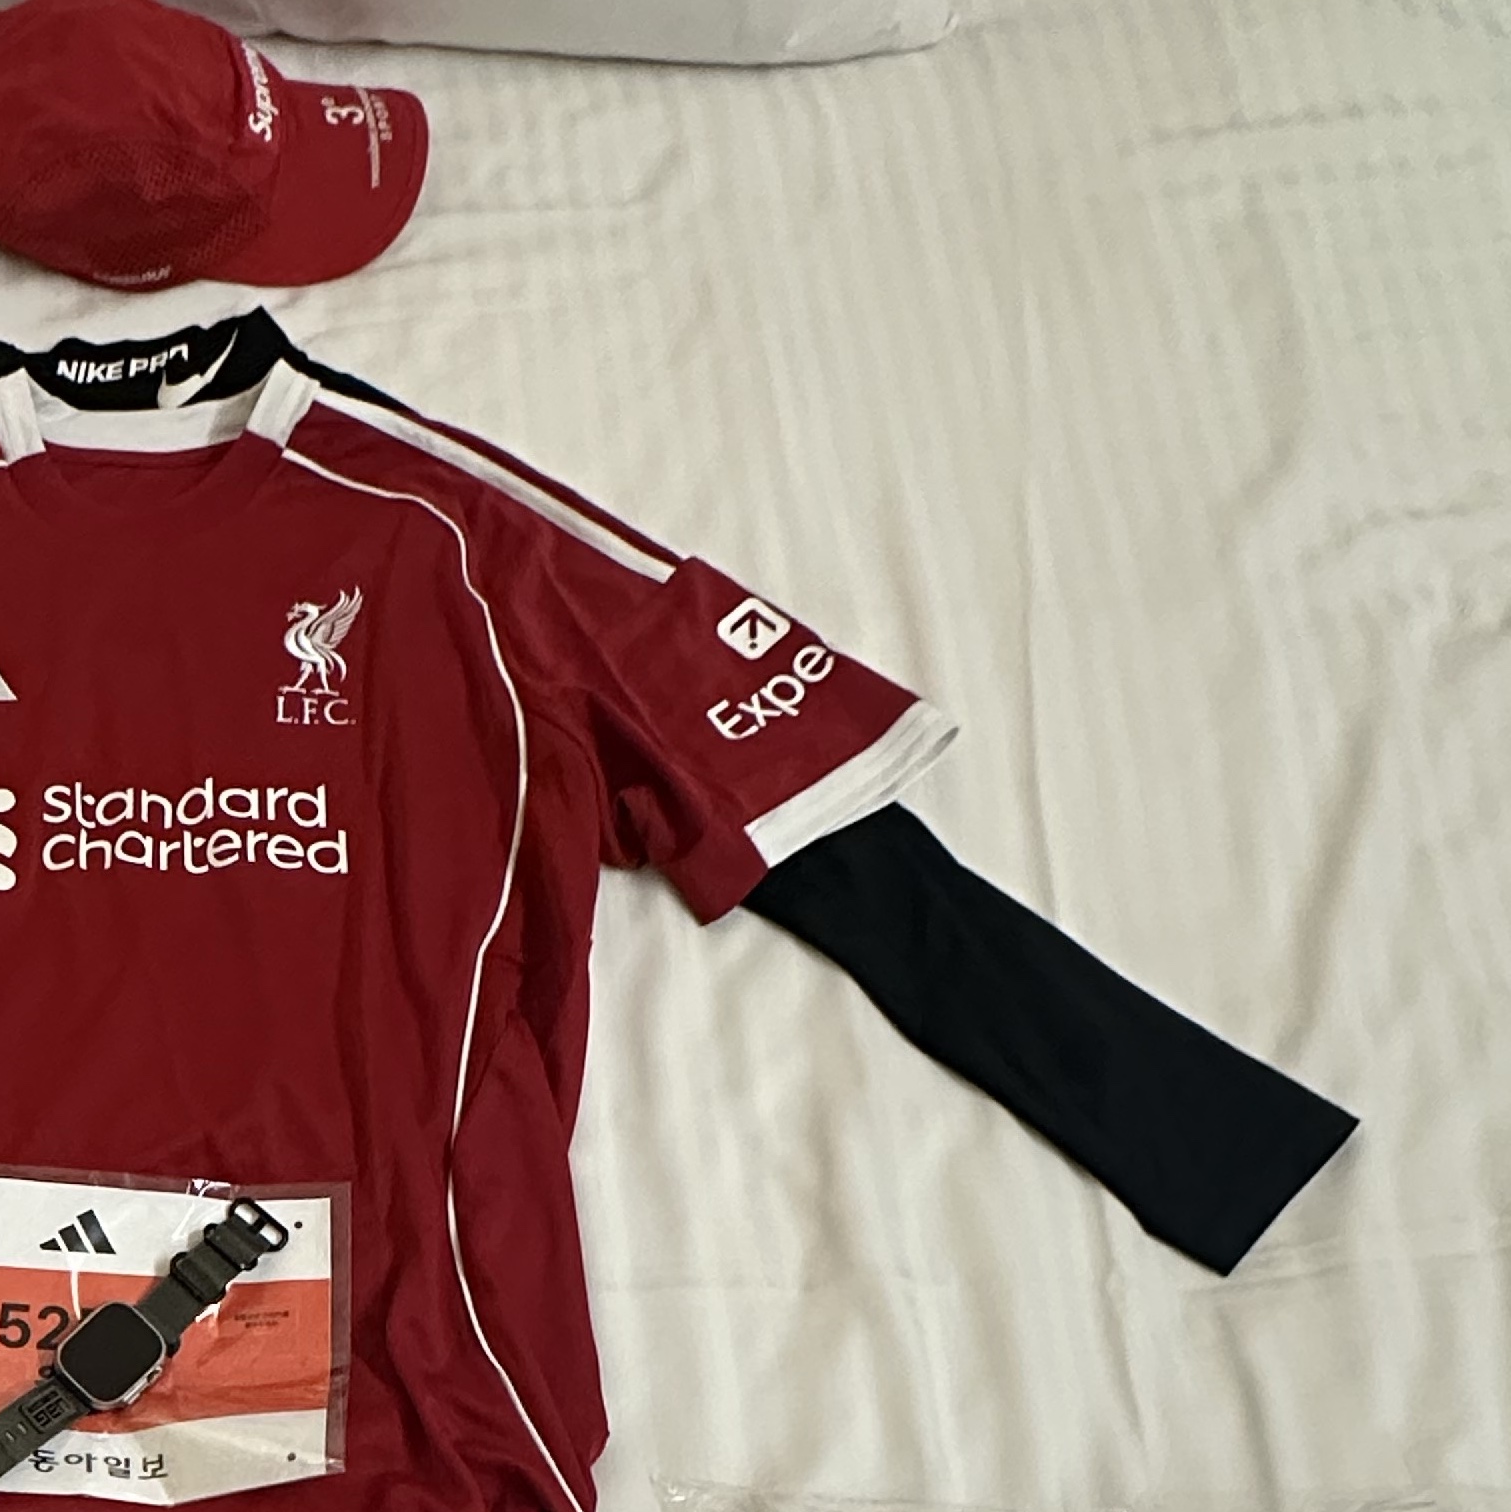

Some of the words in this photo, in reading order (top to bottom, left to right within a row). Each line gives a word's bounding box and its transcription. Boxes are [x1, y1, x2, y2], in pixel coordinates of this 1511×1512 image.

[55, 358, 125, 384] NIKE
[275, 696, 357, 725] L.F.C.
[42, 827, 349, 875] chartered
[28, 1449, 169, 1480] 동아일보
